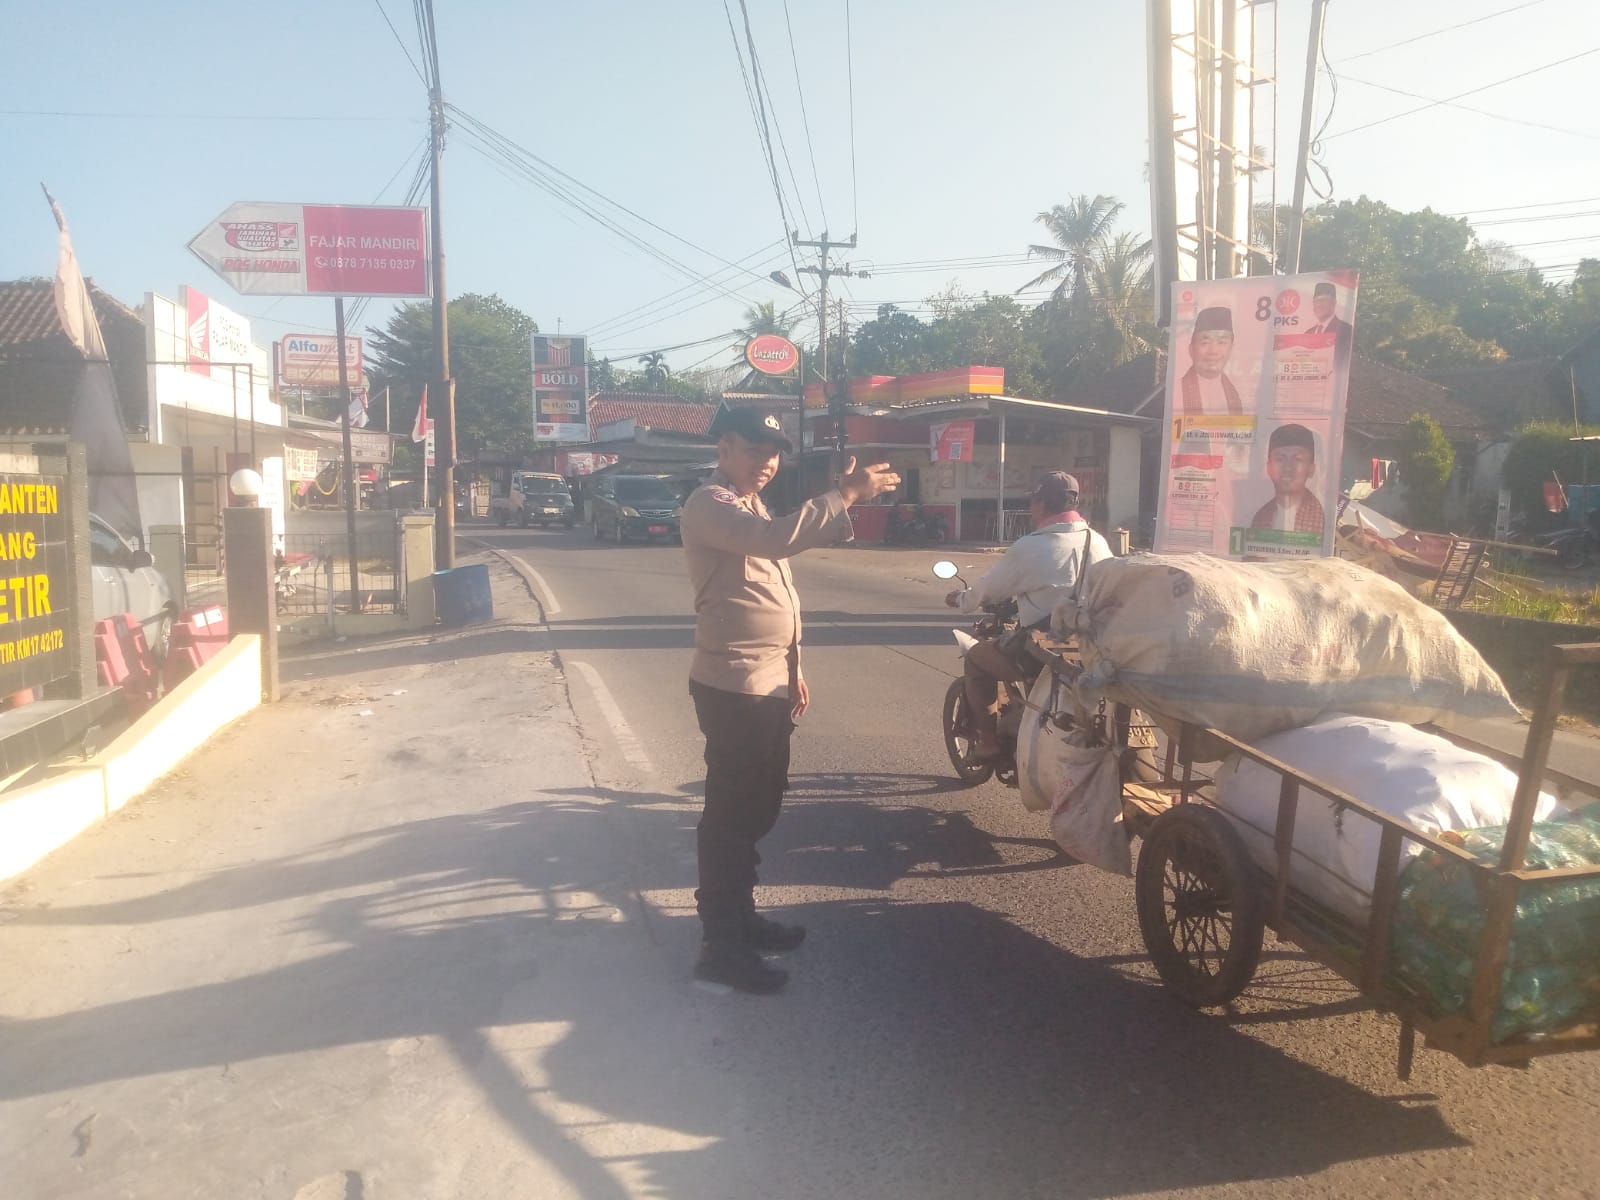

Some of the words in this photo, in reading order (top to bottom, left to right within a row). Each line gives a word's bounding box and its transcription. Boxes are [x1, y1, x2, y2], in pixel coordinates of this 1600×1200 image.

[309, 235, 357, 248] FAJAR
[361, 237, 419, 251] MANDIRI
[255, 259, 297, 272] HONDA
[360, 258, 387, 269] 7135
[1255, 296, 1271, 321] 8
[1274, 316, 1299, 327] PKS
[541, 373, 578, 385] BOLD
[1174, 418, 1182, 439] 1
[0, 483, 58, 514] ANTEN
[1232, 531, 1242, 555] 1
[0, 574, 52, 624] ETIR
